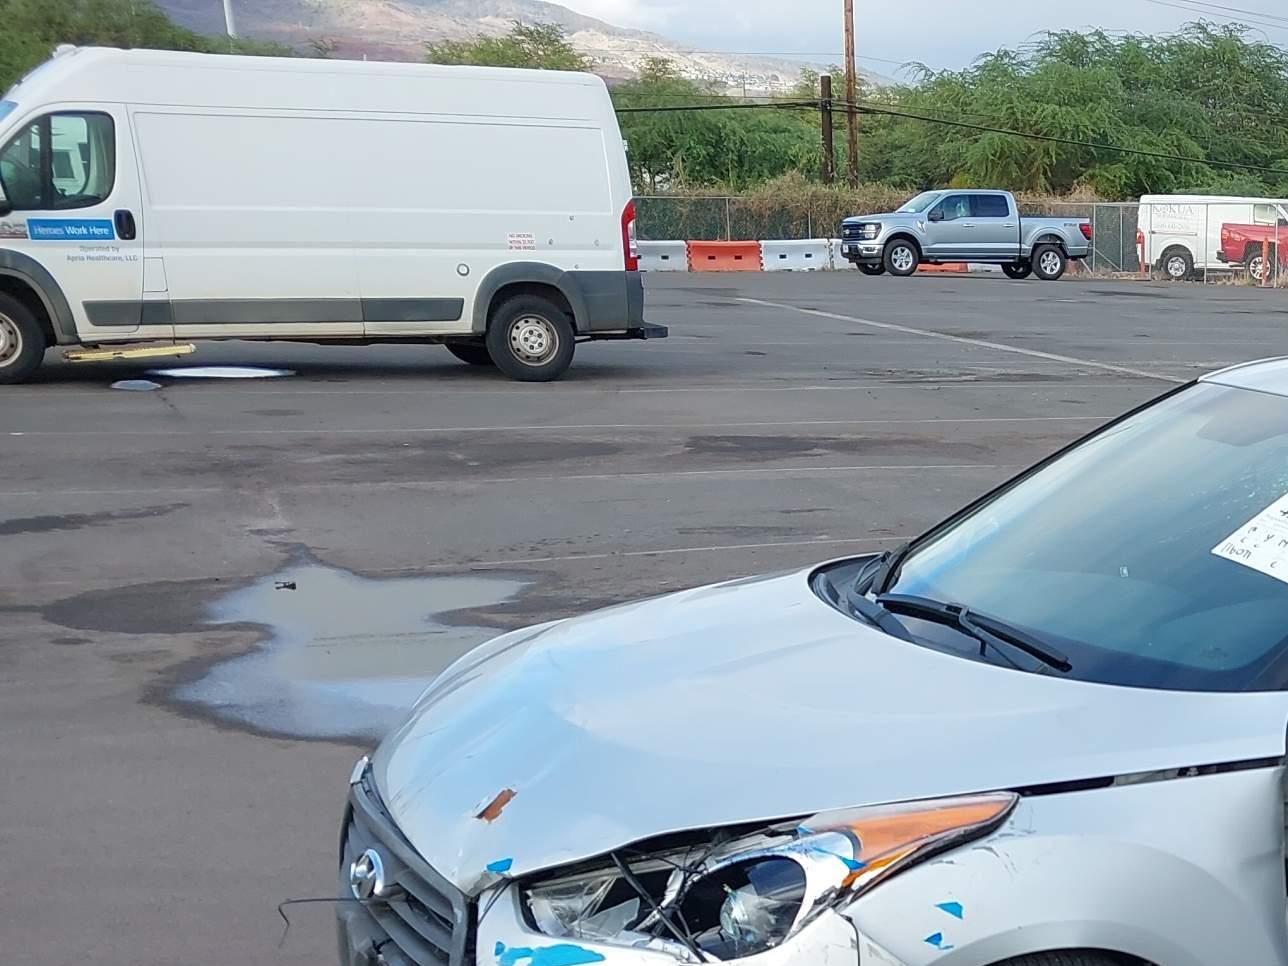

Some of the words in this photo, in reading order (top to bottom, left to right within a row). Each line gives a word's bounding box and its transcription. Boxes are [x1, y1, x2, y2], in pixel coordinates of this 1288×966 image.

[33, 225, 64, 235] Heroes
[65, 225, 88, 235] Work
[89, 225, 110, 235] Here
